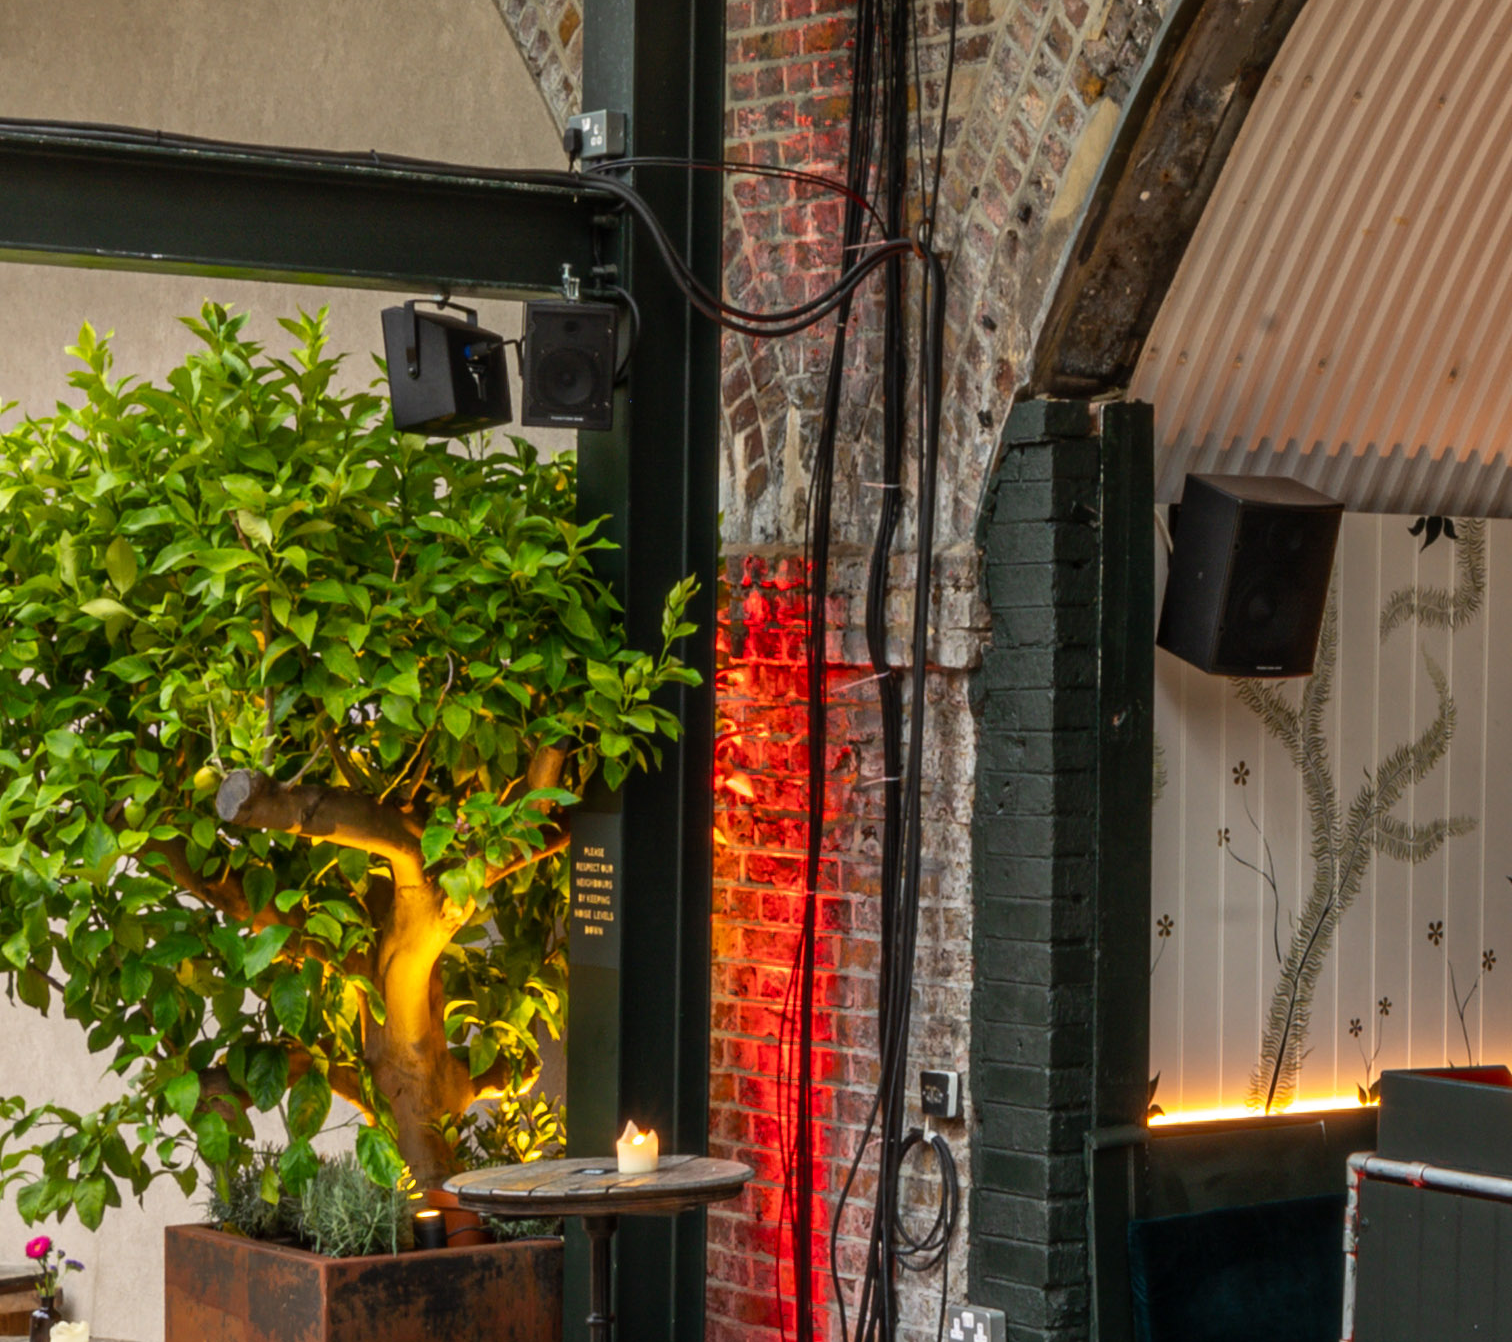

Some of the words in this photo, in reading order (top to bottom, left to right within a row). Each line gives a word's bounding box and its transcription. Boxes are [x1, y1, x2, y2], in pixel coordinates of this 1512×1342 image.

[583, 847, 604, 857] PLEASE
[575, 862, 600, 872] RESPECT
[575, 878, 613, 889] NEIGHBOURS
[586, 894, 610, 904] KEEPING
[574, 909, 591, 919] NOISE
[593, 911, 614, 921] LEVELS
[584, 925, 603, 935] DOWN
